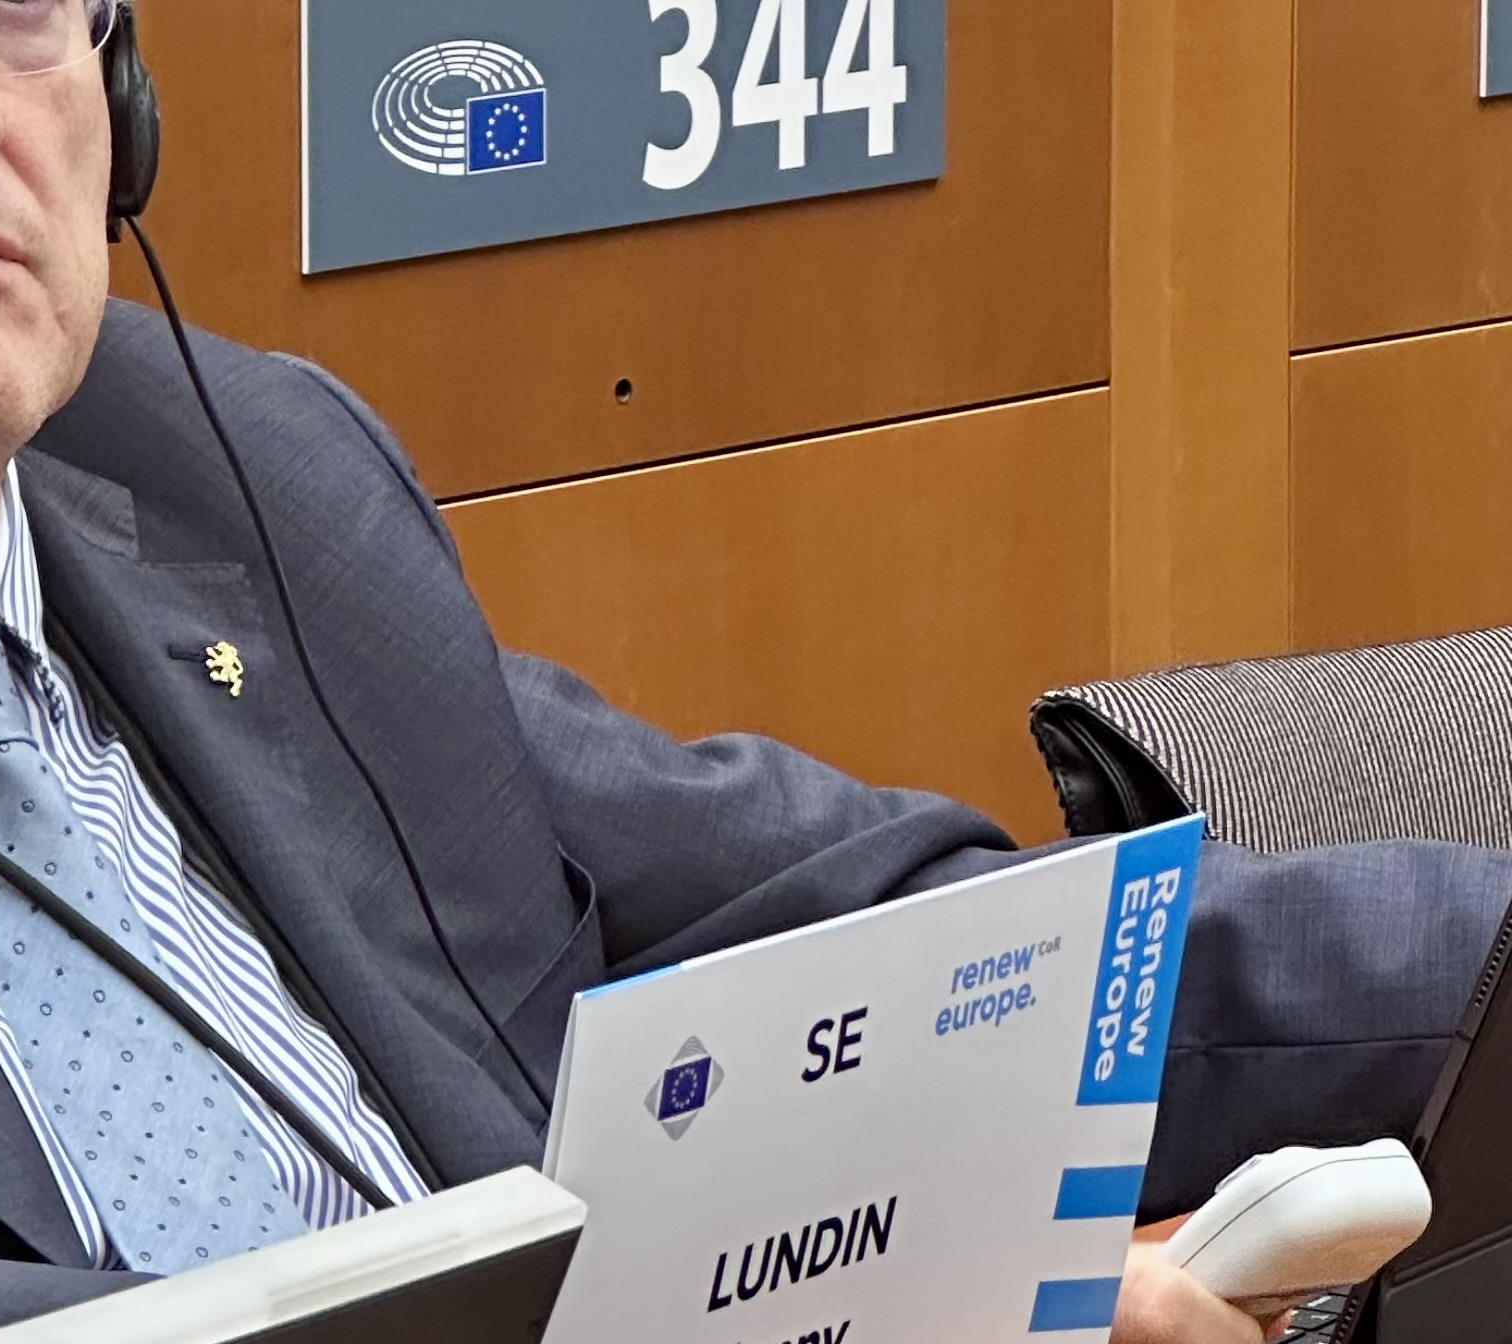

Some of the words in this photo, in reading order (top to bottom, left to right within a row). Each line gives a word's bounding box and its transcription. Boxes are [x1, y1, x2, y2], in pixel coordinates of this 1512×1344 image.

[935, 982, 1037, 1036] europe.
[951, 942, 1036, 994] renew
[1038, 935, 1062, 957] CoR
[1094, 875, 1151, 1081] Europe
[1126, 866, 1182, 1057] Renew
[801, 1006, 869, 1083] SE
[705, 1195, 898, 1313] LUNDIN
